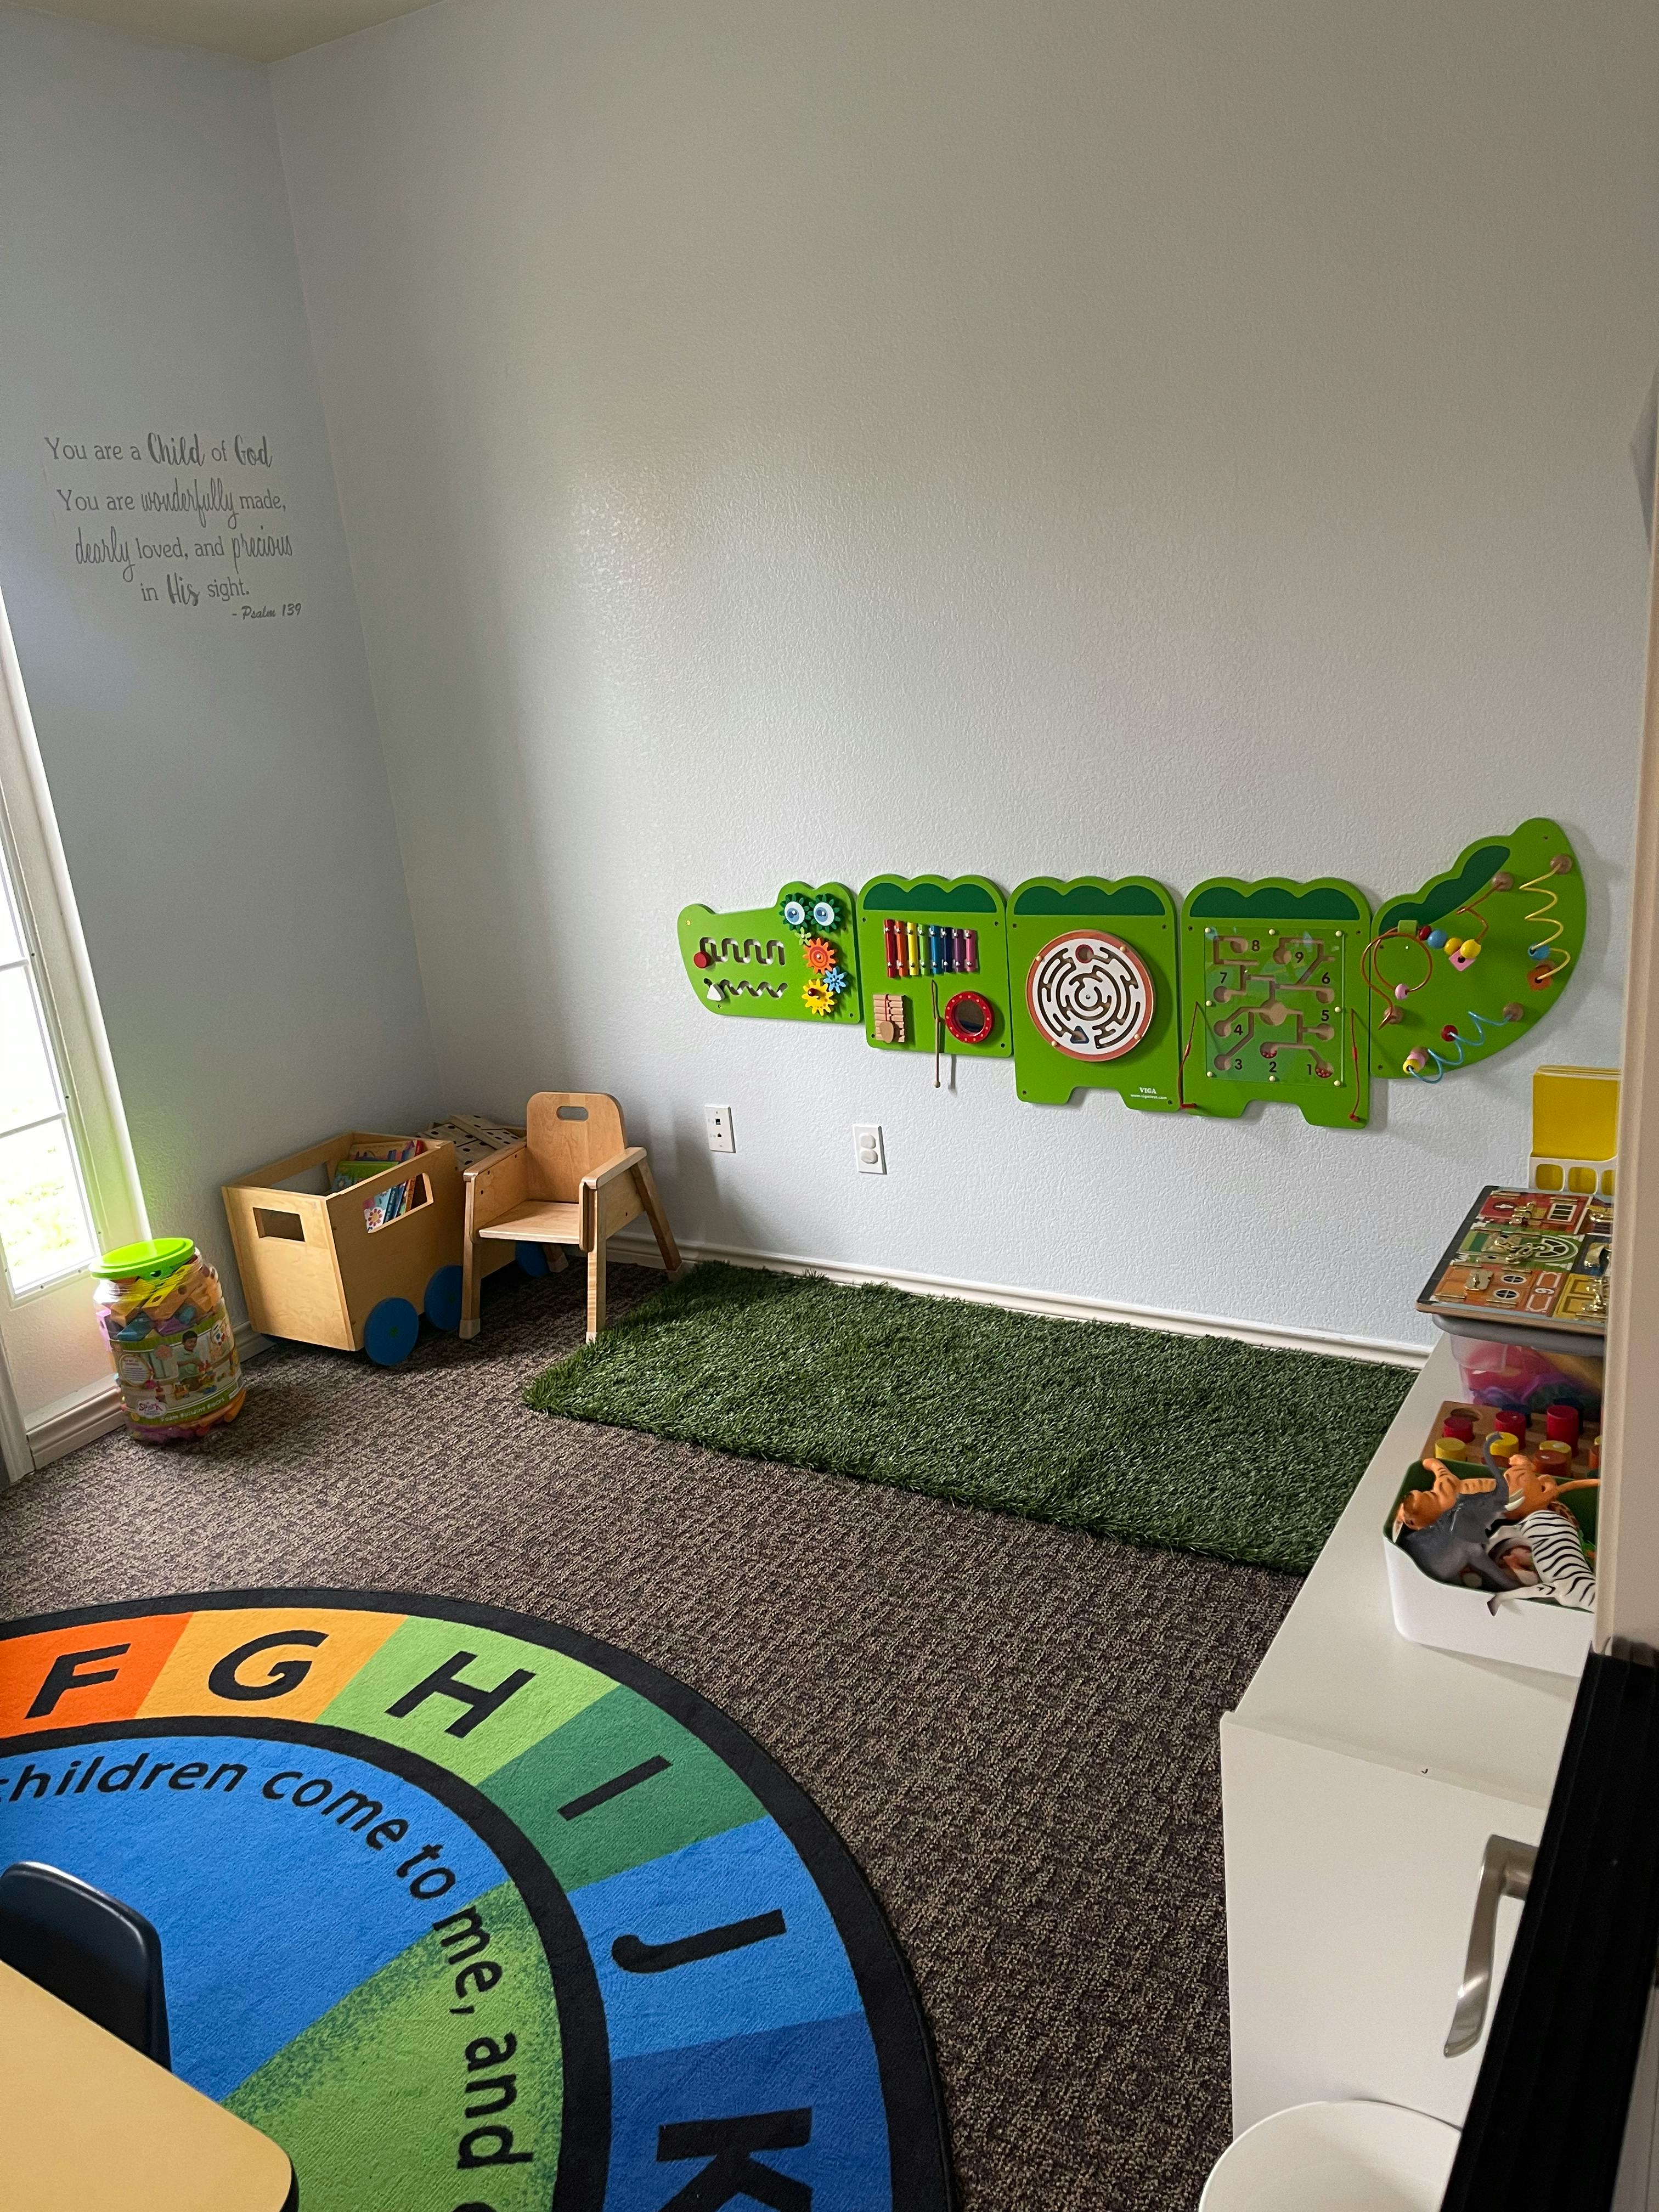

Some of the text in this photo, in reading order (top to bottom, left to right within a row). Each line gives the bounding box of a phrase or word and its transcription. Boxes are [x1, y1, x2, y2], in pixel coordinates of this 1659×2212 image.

[44, 432, 273, 468] You are a Child of God
[57, 477, 286, 529] You are wonderfully made,
[75, 524, 293, 583] dearly loved, and precious
[140, 572, 250, 607] in His sight.
[241, 606, 276, 620] Psalm
[281, 603, 302, 617] 139
[1251, 939, 1260, 952] 8
[1295, 951, 1304, 963] 9
[1220, 972, 1228, 984] 7
[1321, 972, 1331, 984] 6
[1321, 1009, 1329, 1022] 5
[1233, 1024, 1244, 1036] 4
[1234, 1058, 1243, 1070] 3
[1268, 1061, 1277, 1073] 2
[1306, 1064, 1312, 1075] 1
[25, 1629, 814, 2212] F G H I J K
[0, 1752, 535, 2171] hildren come to me, and
